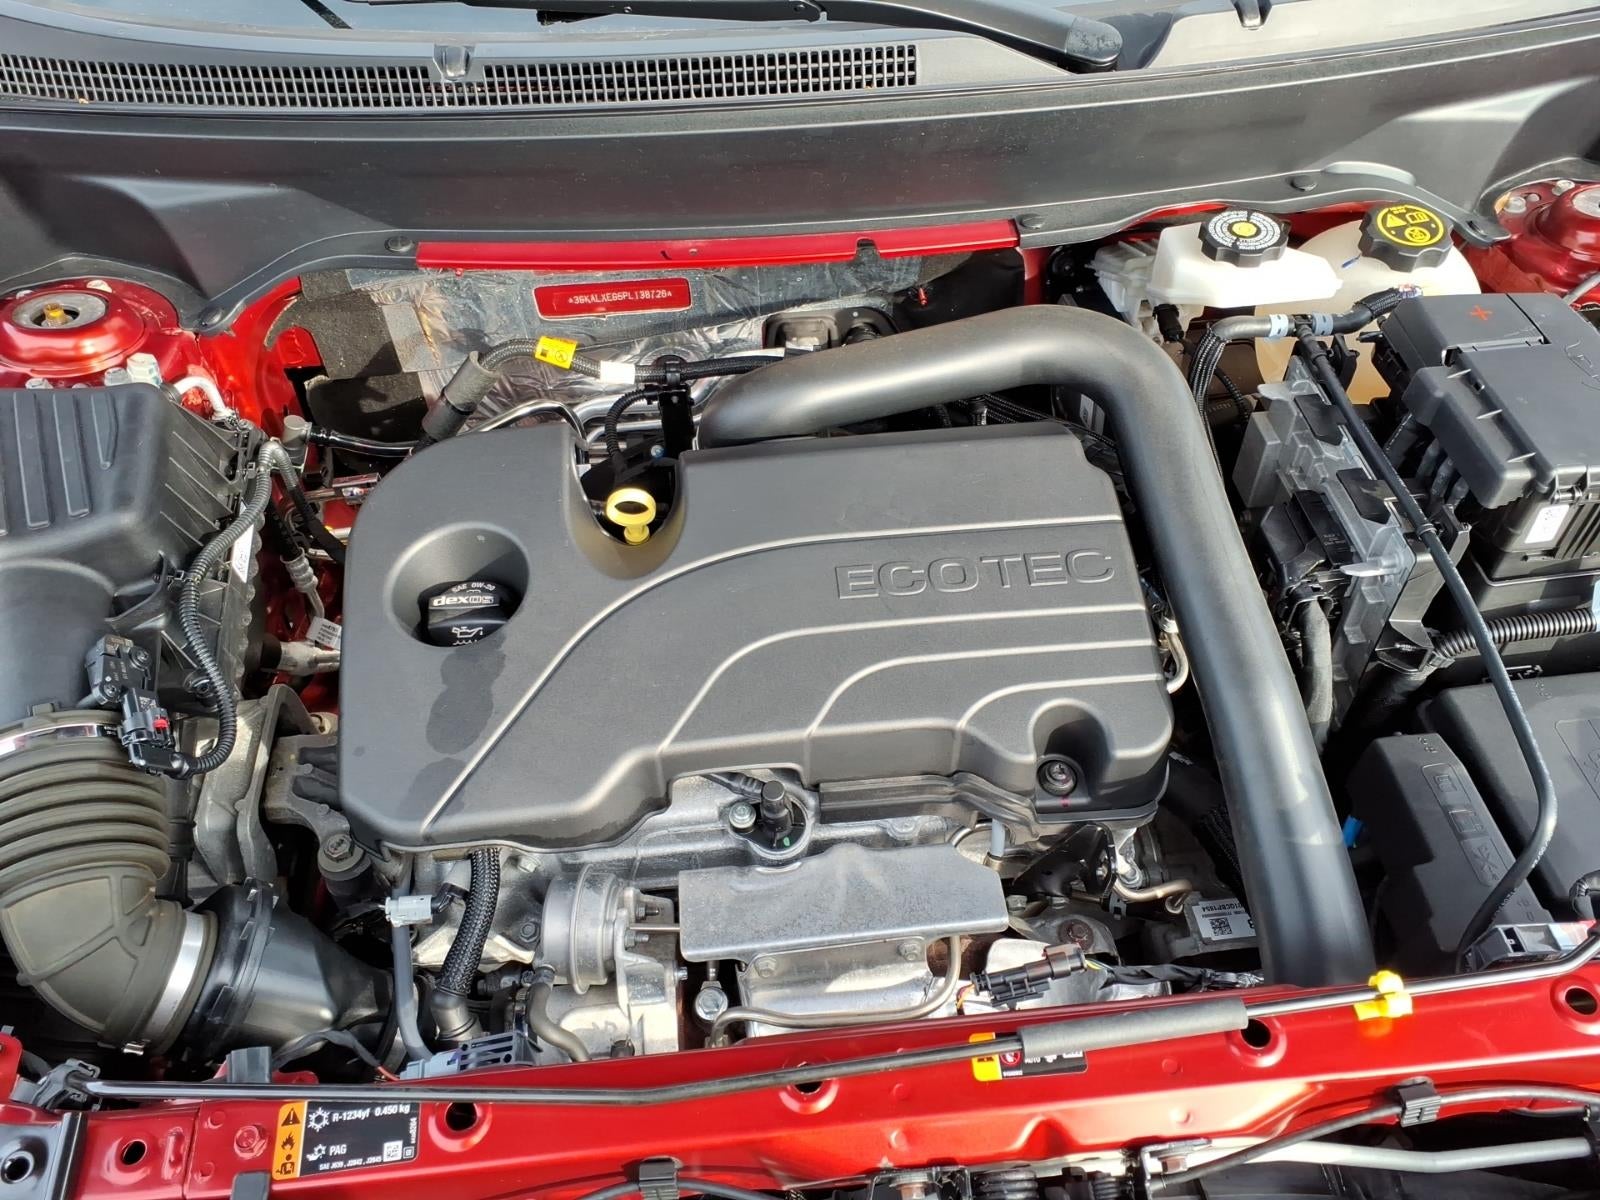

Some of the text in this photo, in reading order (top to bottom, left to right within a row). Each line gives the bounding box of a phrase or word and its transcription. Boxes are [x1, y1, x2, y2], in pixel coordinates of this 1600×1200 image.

[835, 548, 1115, 600] ECOTEC
[451, 583, 467, 593] SAE
[432, 595, 494, 607] dexos
[332, 1103, 411, 1122] R-1234yf 0.450 kg
[329, 1144, 347, 1156] PAG
